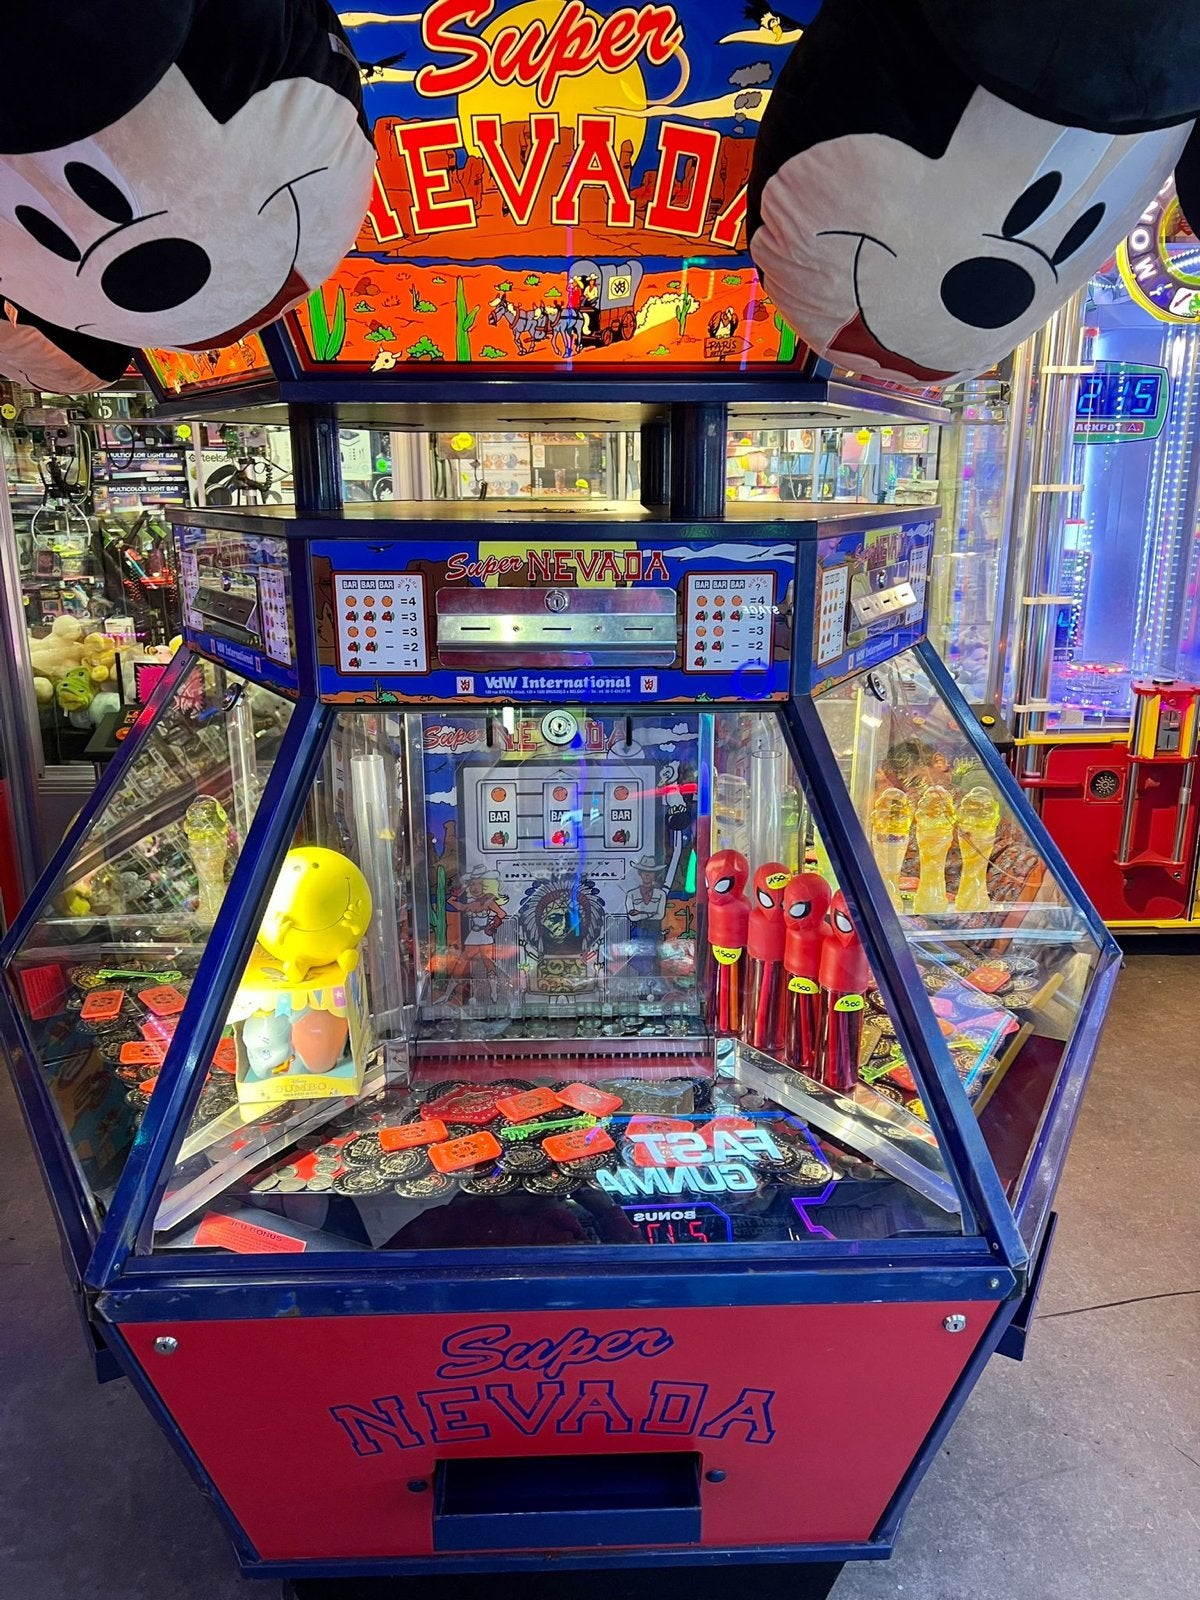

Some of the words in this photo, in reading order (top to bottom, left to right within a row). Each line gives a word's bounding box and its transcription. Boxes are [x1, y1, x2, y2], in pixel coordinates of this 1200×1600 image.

[415, 0, 683, 107] Super
[354, 113, 748, 251] EVAD
[1075, 423, 1122, 431] ACKPOT
[445, 552, 525, 582] Super
[527, 549, 670, 581] NEVADA
[343, 581, 358, 589] BAR
[361, 581, 376, 589] BAR
[379, 581, 394, 589] BAR
[695, 581, 710, 589] BAR
[713, 581, 727, 589] BAR
[730, 581, 745, 589] BAR
[484, 676, 518, 689] VdW
[522, 675, 631, 689] International
[422, 725, 486, 750] Super
[492, 720, 627, 751] NEDA
[489, 811, 509, 822] BAR
[612, 810, 631, 821] BAR
[715, 949, 737, 959] 1500
[791, 982, 811, 992] 1500
[840, 1000, 861, 1008] 1500
[275, 1083, 327, 1094] DUMBO
[250, 1227, 282, 1242] BONUS
[436, 1323, 675, 1380] Super
[328, 1379, 776, 1457] NEVADA
